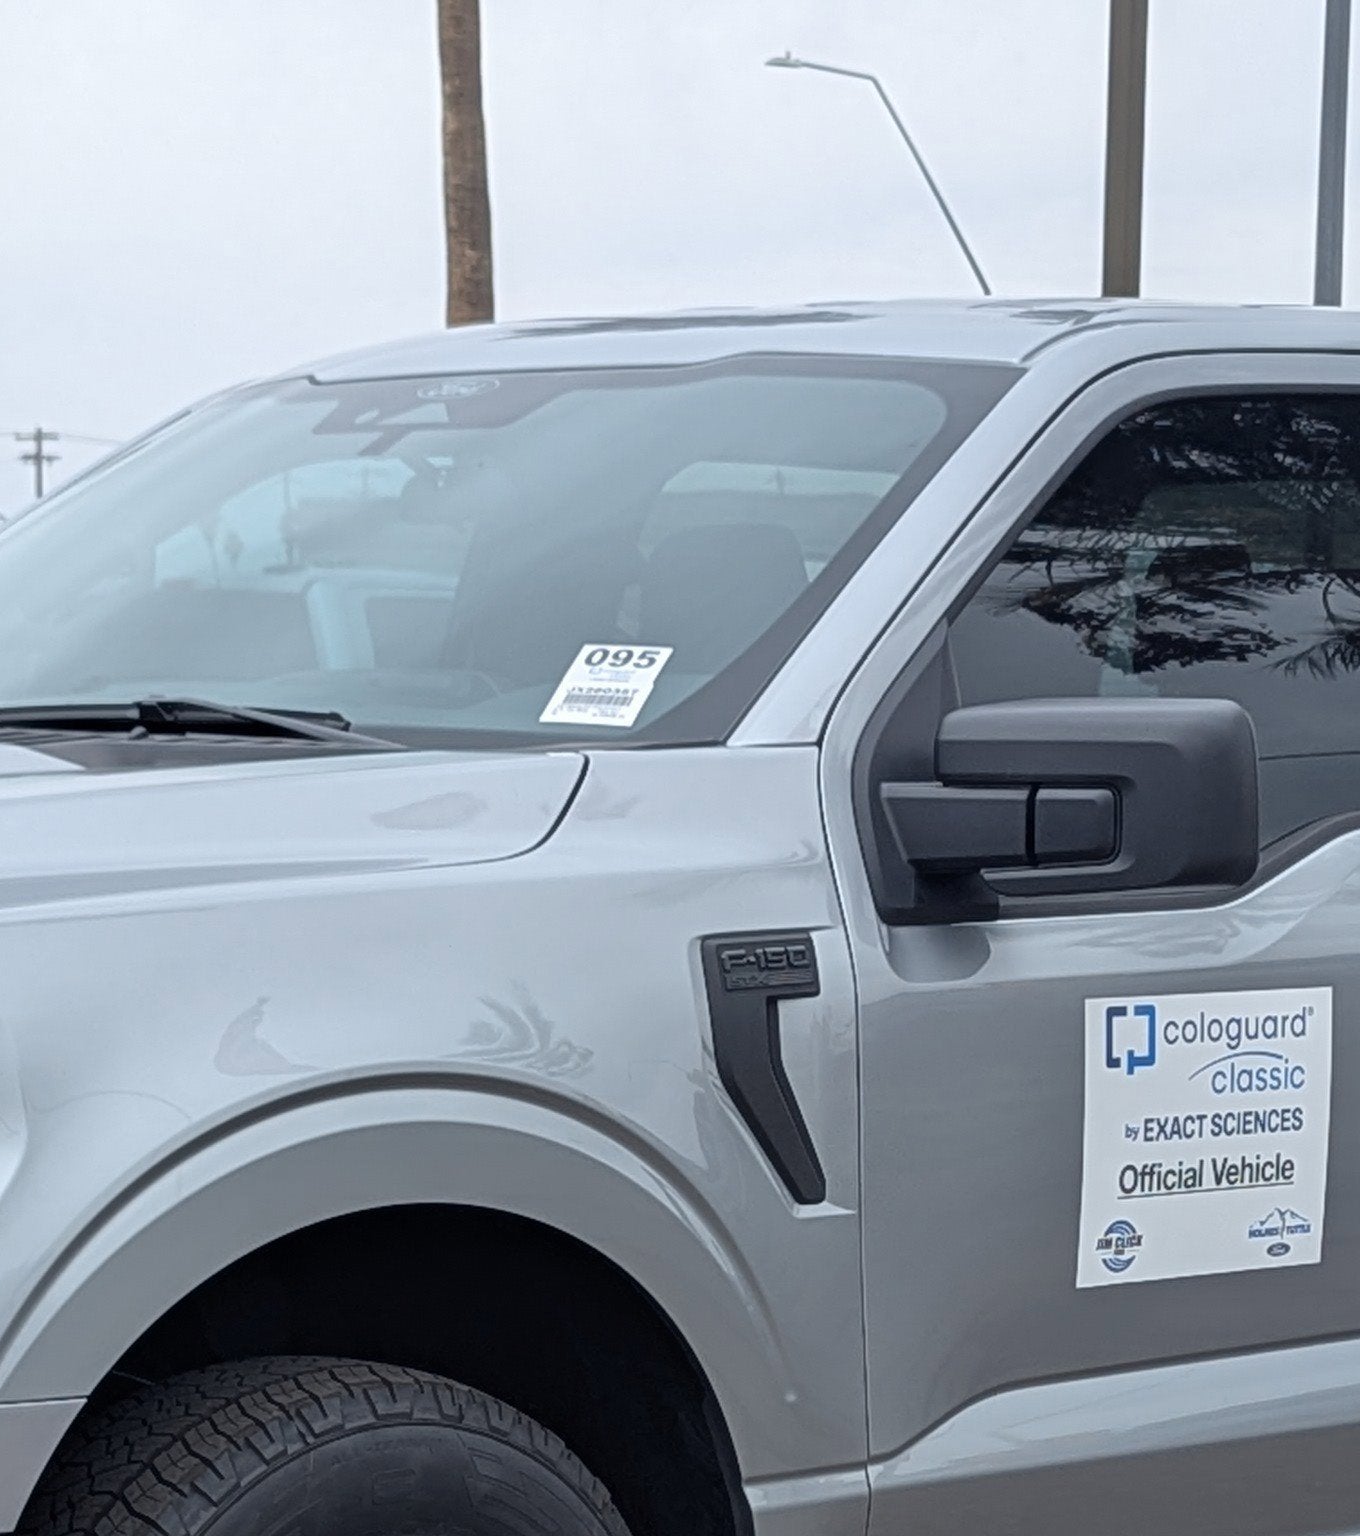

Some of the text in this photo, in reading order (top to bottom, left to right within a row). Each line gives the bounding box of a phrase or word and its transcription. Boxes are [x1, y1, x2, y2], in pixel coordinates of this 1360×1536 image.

[584, 648, 661, 669] 095
[720, 945, 810, 973] F-150
[1212, 1058, 1306, 1094] classic
[1125, 1107, 1304, 1142] by EXACT SCIENCES
[1118, 1152, 1295, 1194] Official Vehicle
